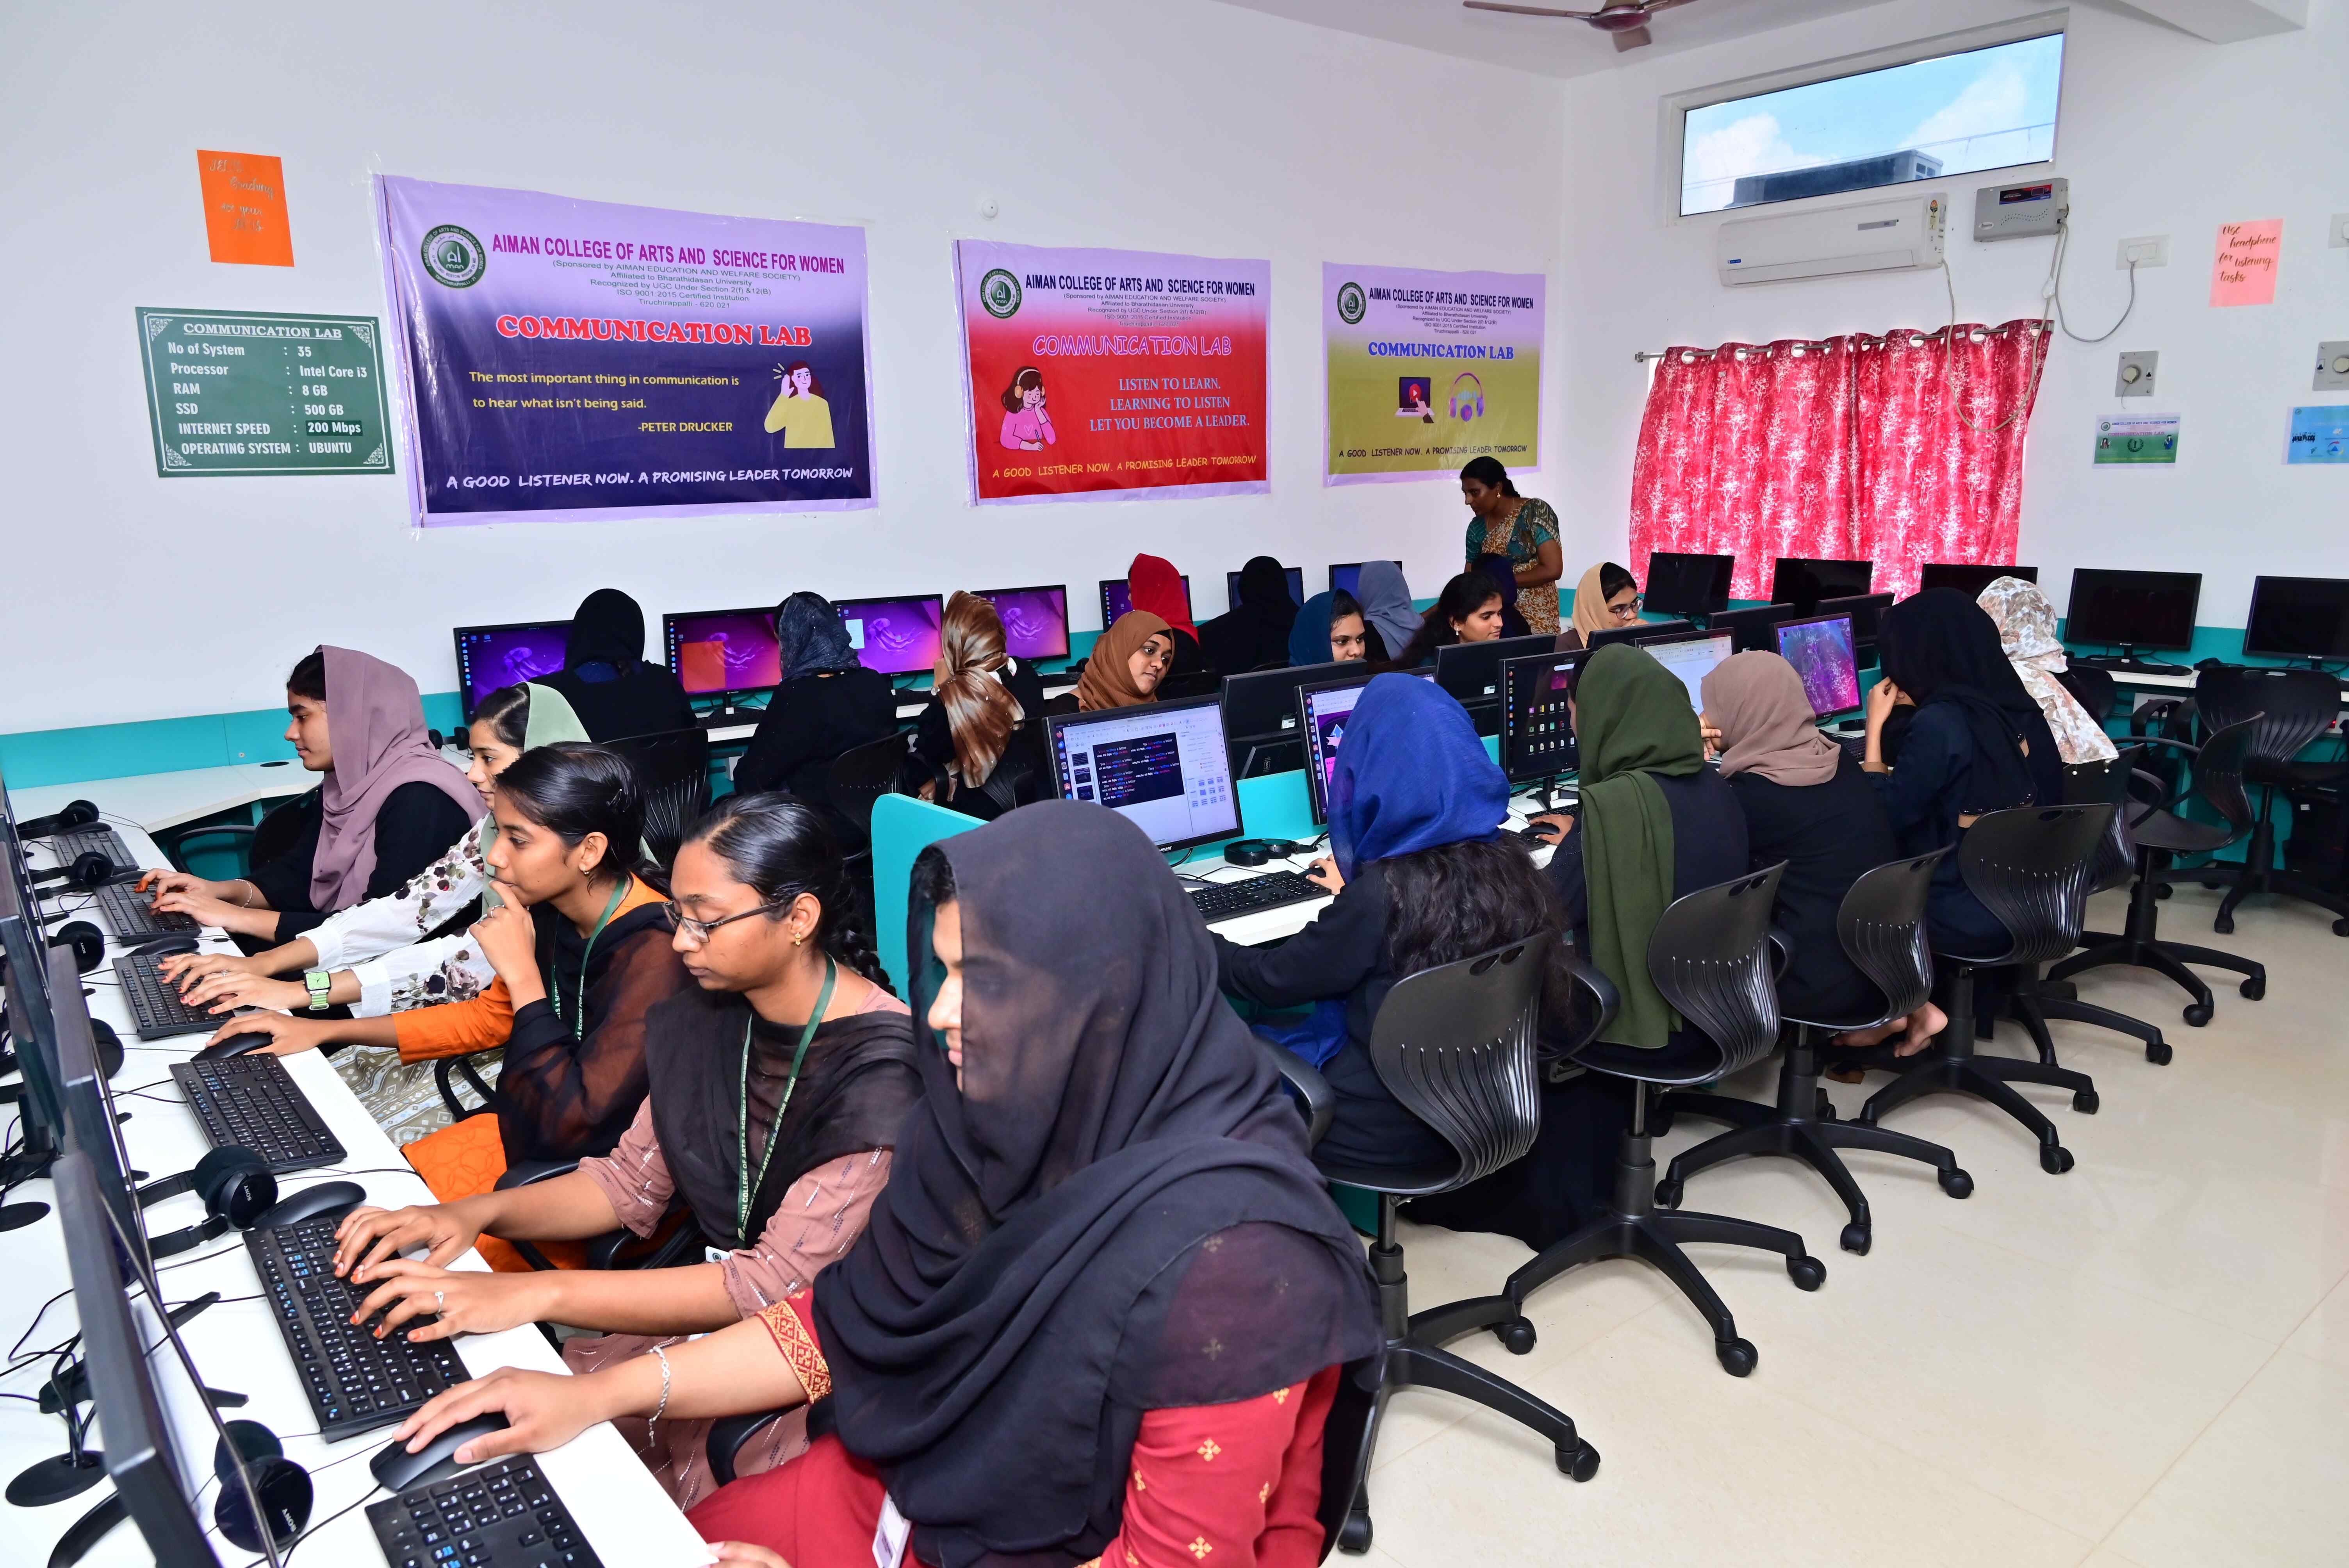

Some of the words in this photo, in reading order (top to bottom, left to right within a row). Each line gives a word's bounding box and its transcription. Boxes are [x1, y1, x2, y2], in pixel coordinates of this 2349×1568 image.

[2222, 225, 2241, 235] Use
[492, 234, 540, 255] AIMAN
[544, 237, 612, 259] COLLEGE
[616, 242, 634, 260] OF
[639, 244, 674, 263] ARTS
[678, 247, 706, 265] AND
[713, 249, 768, 269] SCIENCE
[771, 253, 797, 271] FOR
[799, 255, 845, 274] WOMEN
[2219, 252, 2233, 264] for
[2235, 257, 2275, 272] listening
[553, 260, 601, 269] (Sponsored
[647, 265, 698, 274] EDUCATION
[720, 270, 760, 278] WELFARE
[763, 273, 800, 282] SOCIETY)
[2218, 271, 2246, 283] tasks
[590, 279, 638, 289] Recognized
[658, 274, 713, 284] Bharathidasan
[715, 278, 752, 287] University
[1025, 274, 1057, 289] AIMAN
[1059, 275, 1103, 290] COLLEGE
[1105, 276, 1117, 291] OF
[1119, 277, 1142, 292] ARTS
[1145, 278, 1163, 292] AND
[1168, 279, 1205, 294] SCIENCE
[1207, 280, 1224, 295] FOR
[1225, 282, 1255, 296] WOMEN
[638, 298, 693, 307] Tiruchirappalli
[1369, 287, 1391, 300] AIMAN
[1393, 289, 1423, 303] COLLEGE
[1425, 291, 1434, 303] OF
[1435, 292, 1452, 304] ARTS
[1454, 293, 1467, 305] AND
[1470, 294, 1496, 307] SCIENCE
[1498, 296, 1510, 308] FOR
[1511, 297, 1534, 309] WOMEN
[184, 323, 310, 337] COMMUNICATION
[315, 328, 342, 339] LAB
[496, 314, 754, 346] COMMUNICATION
[759, 324, 813, 347] LAB
[168, 342, 184, 354] No
[187, 342, 200, 354] of
[203, 343, 245, 357] System
[297, 346, 312, 357] 35
[1032, 335, 1197, 356] COMMUNICATION
[1200, 336, 1232, 356] LAB
[1368, 342, 1486, 359] COMMUNICATION
[1489, 346, 1514, 360] LAB
[171, 362, 229, 375] Processor
[299, 365, 326, 377] Intel
[328, 366, 354, 378] Core
[356, 367, 367, 378] i3
[469, 372, 494, 383] The
[497, 373, 528, 383] most
[531, 372, 592, 386] important
[595, 374, 626, 387] thing
[629, 374, 640, 385] in
[643, 375, 729, 386] communication
[731, 375, 740, 386] is
[1119, 378, 1158, 391] LISTEN
[1161, 378, 1180, 390] TO
[1182, 377, 1221, 390] LEARN.
[173, 383, 200, 395] RAM
[302, 385, 310, 396] 8
[313, 385, 328, 396] GB
[176, 403, 198, 415] SSD
[305, 404, 326, 415] 500
[329, 404, 344, 415] GB
[472, 398, 485, 408] to
[488, 397, 518, 408] hear
[520, 398, 553, 408] what
[584, 398, 618, 411] being
[621, 398, 647, 409] said.
[1110, 397, 1171, 411] LEARNING
[1174, 396, 1191, 409] TO
[1194, 396, 1231, 408] LISTEN
[178, 423, 232, 435] INTERNET
[236, 423, 271, 435] SPEED
[307, 422, 329, 433] 200
[332, 422, 361, 435] Mbps
[637, 422, 676, 433] -PETER
[679, 422, 733, 432] DRUCKER
[1090, 419, 1113, 431] LET
[1114, 417, 1140, 430] YOU
[1143, 415, 1192, 429] BECOME
[1196, 415, 1203, 428] A
[1205, 414, 1250, 428] LEADER.
[181, 443, 245, 454] OPERATING
[249, 442, 291, 454] SYSTEM
[308, 442, 352, 453] UBUNTU
[1371, 447, 1403, 456] LISTENER
[1432, 445, 1468, 455] PROMISING
[1469, 445, 1492, 454] LEADER
[1494, 444, 1527, 453] TOMORROW
[992, 469, 1000, 478] A
[1003, 467, 1032, 477] GOOD
[1038, 463, 1084, 475] LISTENER
[1086, 462, 1113, 473] NOW.
[1116, 461, 1123, 470] A
[1125, 458, 1173, 470] PROMISING
[1176, 456, 1208, 467] LEADER
[1210, 455, 1257, 466] TOMORROW
[446, 475, 458, 489] A
[463, 475, 510, 489] GOOD
[518, 473, 593, 487] LISTENER
[595, 472, 634, 485] NOW.
[638, 472, 649, 485] A
[652, 470, 727, 484] PROMISING
[729, 469, 780, 482] LEADER
[781, 467, 853, 481] TOMORROW
[243, 1185, 252, 1201] SONY
[281, 1507, 297, 1532] SONY
